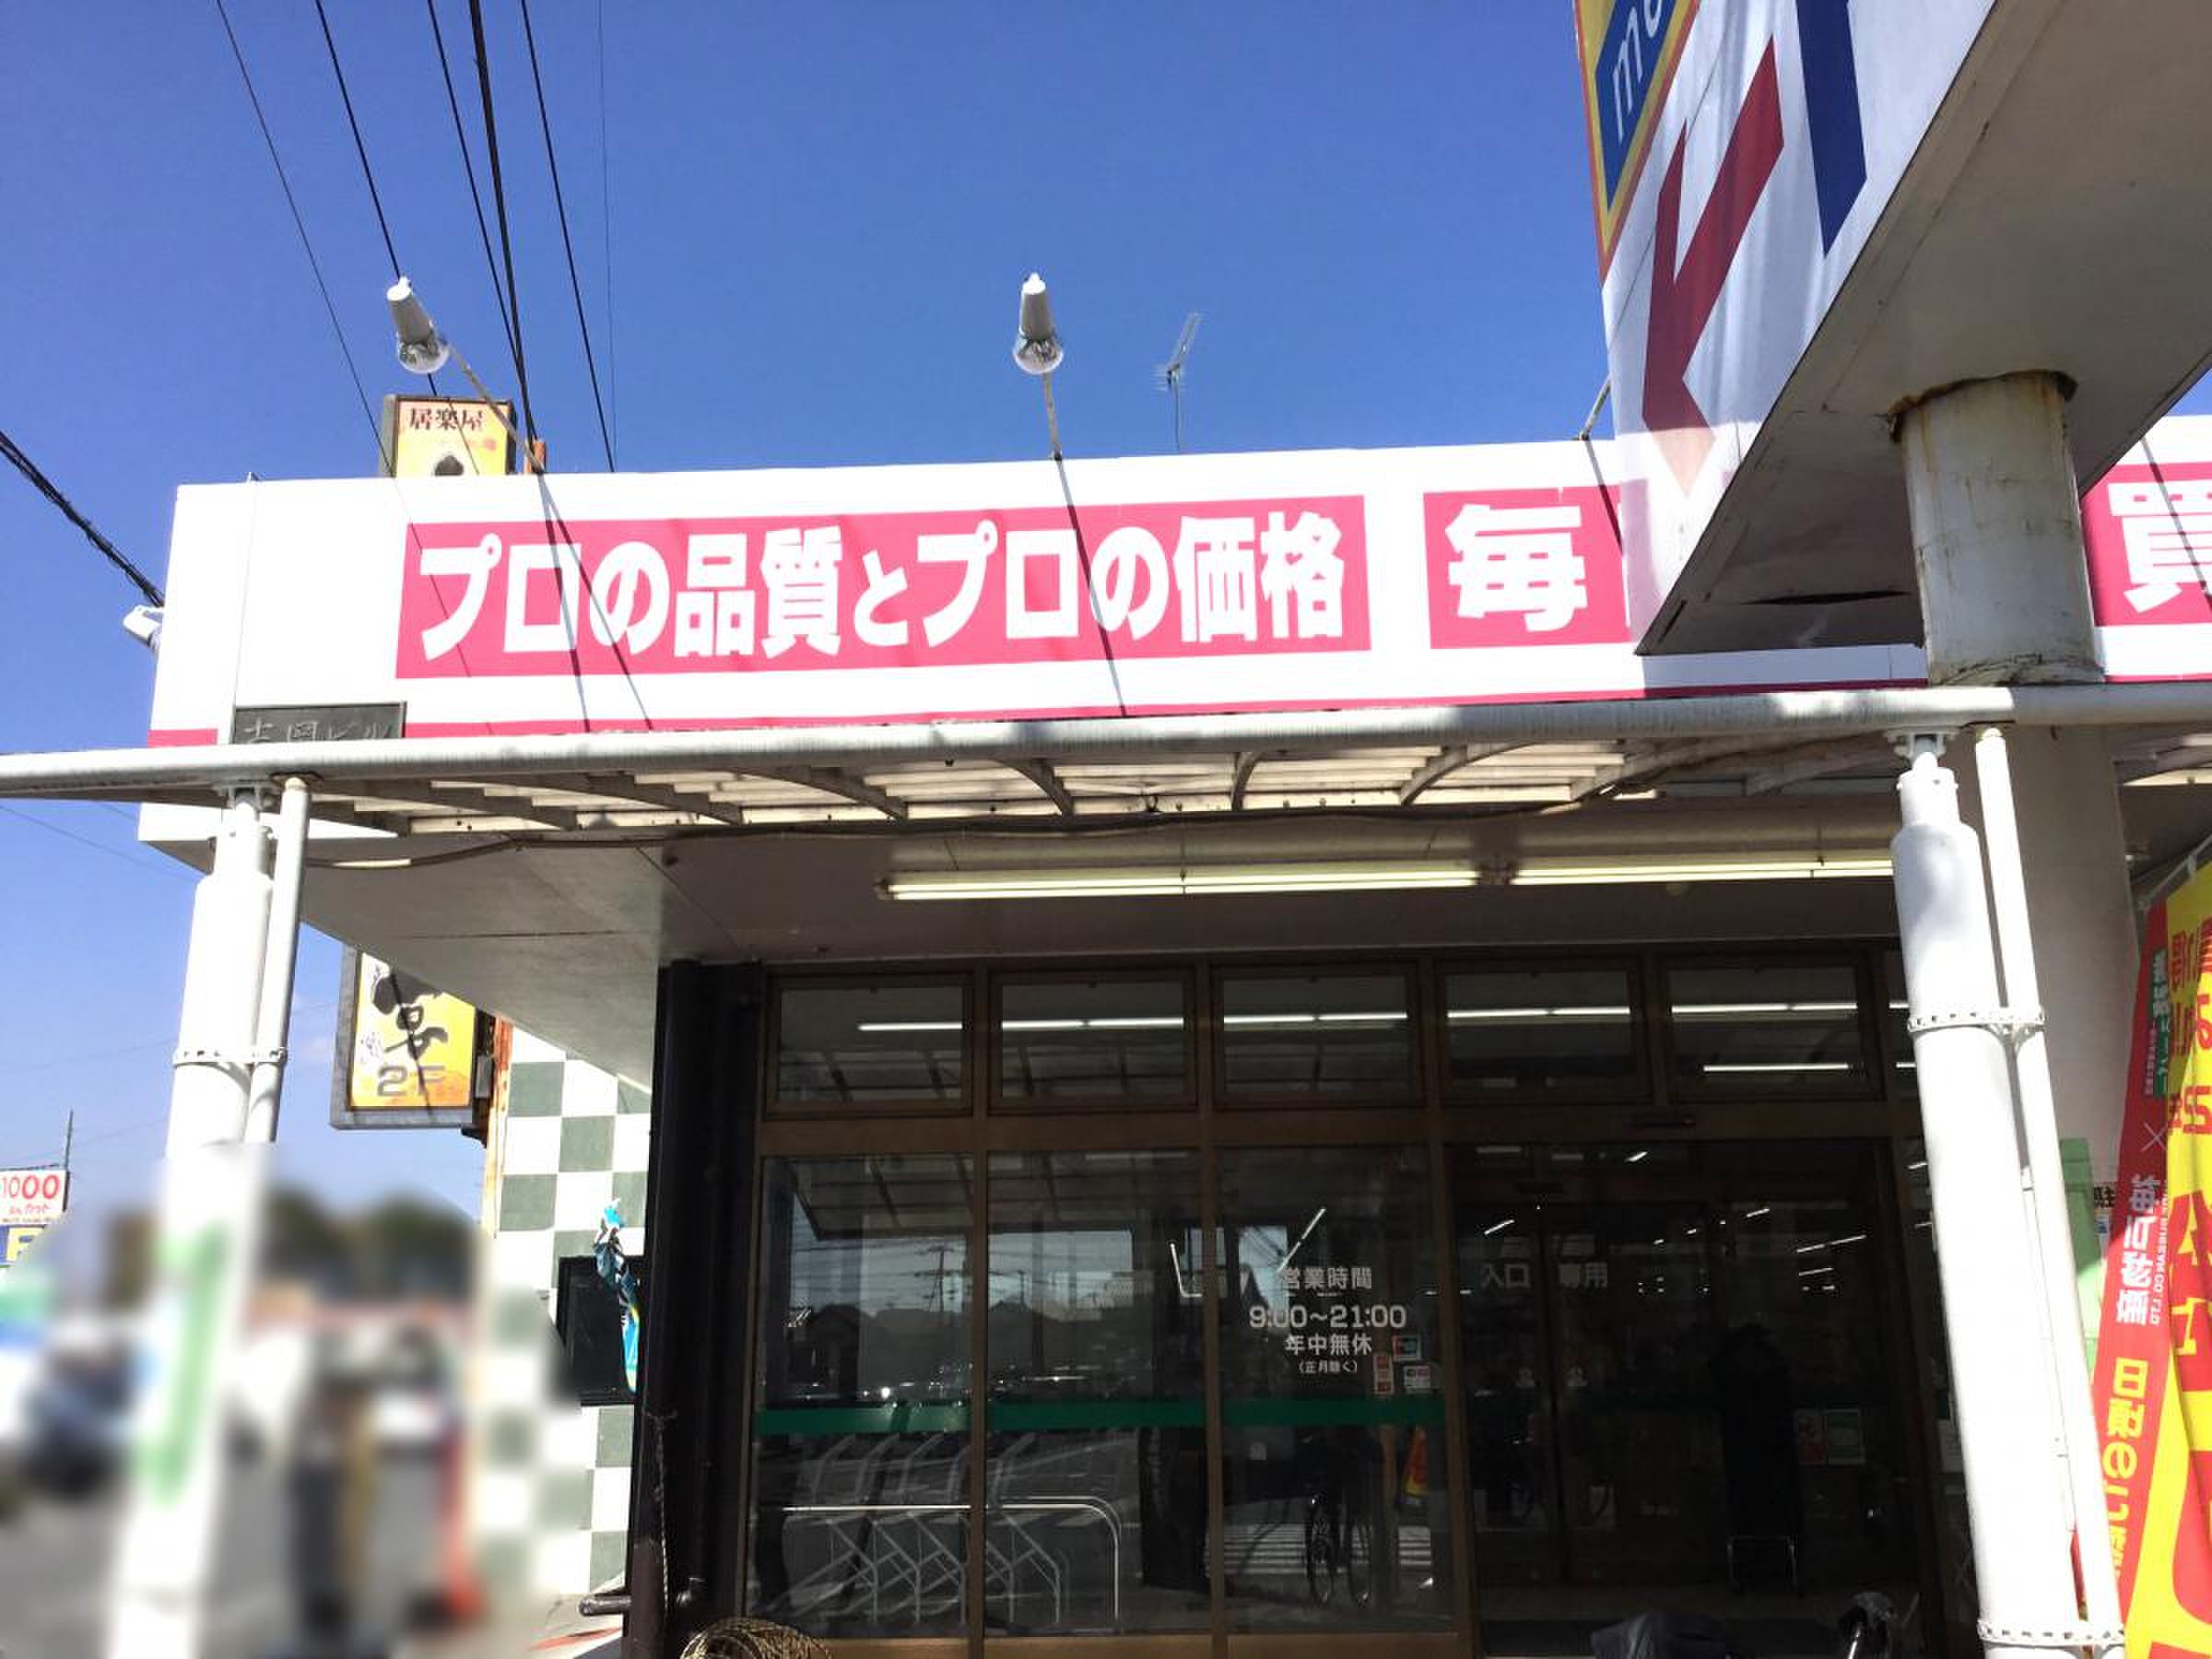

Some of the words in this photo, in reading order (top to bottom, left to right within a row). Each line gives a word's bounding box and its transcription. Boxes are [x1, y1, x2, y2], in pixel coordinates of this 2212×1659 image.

[418, 511, 1346, 662] プロの品質とプロの価格
[1444, 502, 1631, 634] 毎
[1282, 1266, 1372, 1289] 営業時間
[1284, 1333, 1372, 1356] 年中無休
